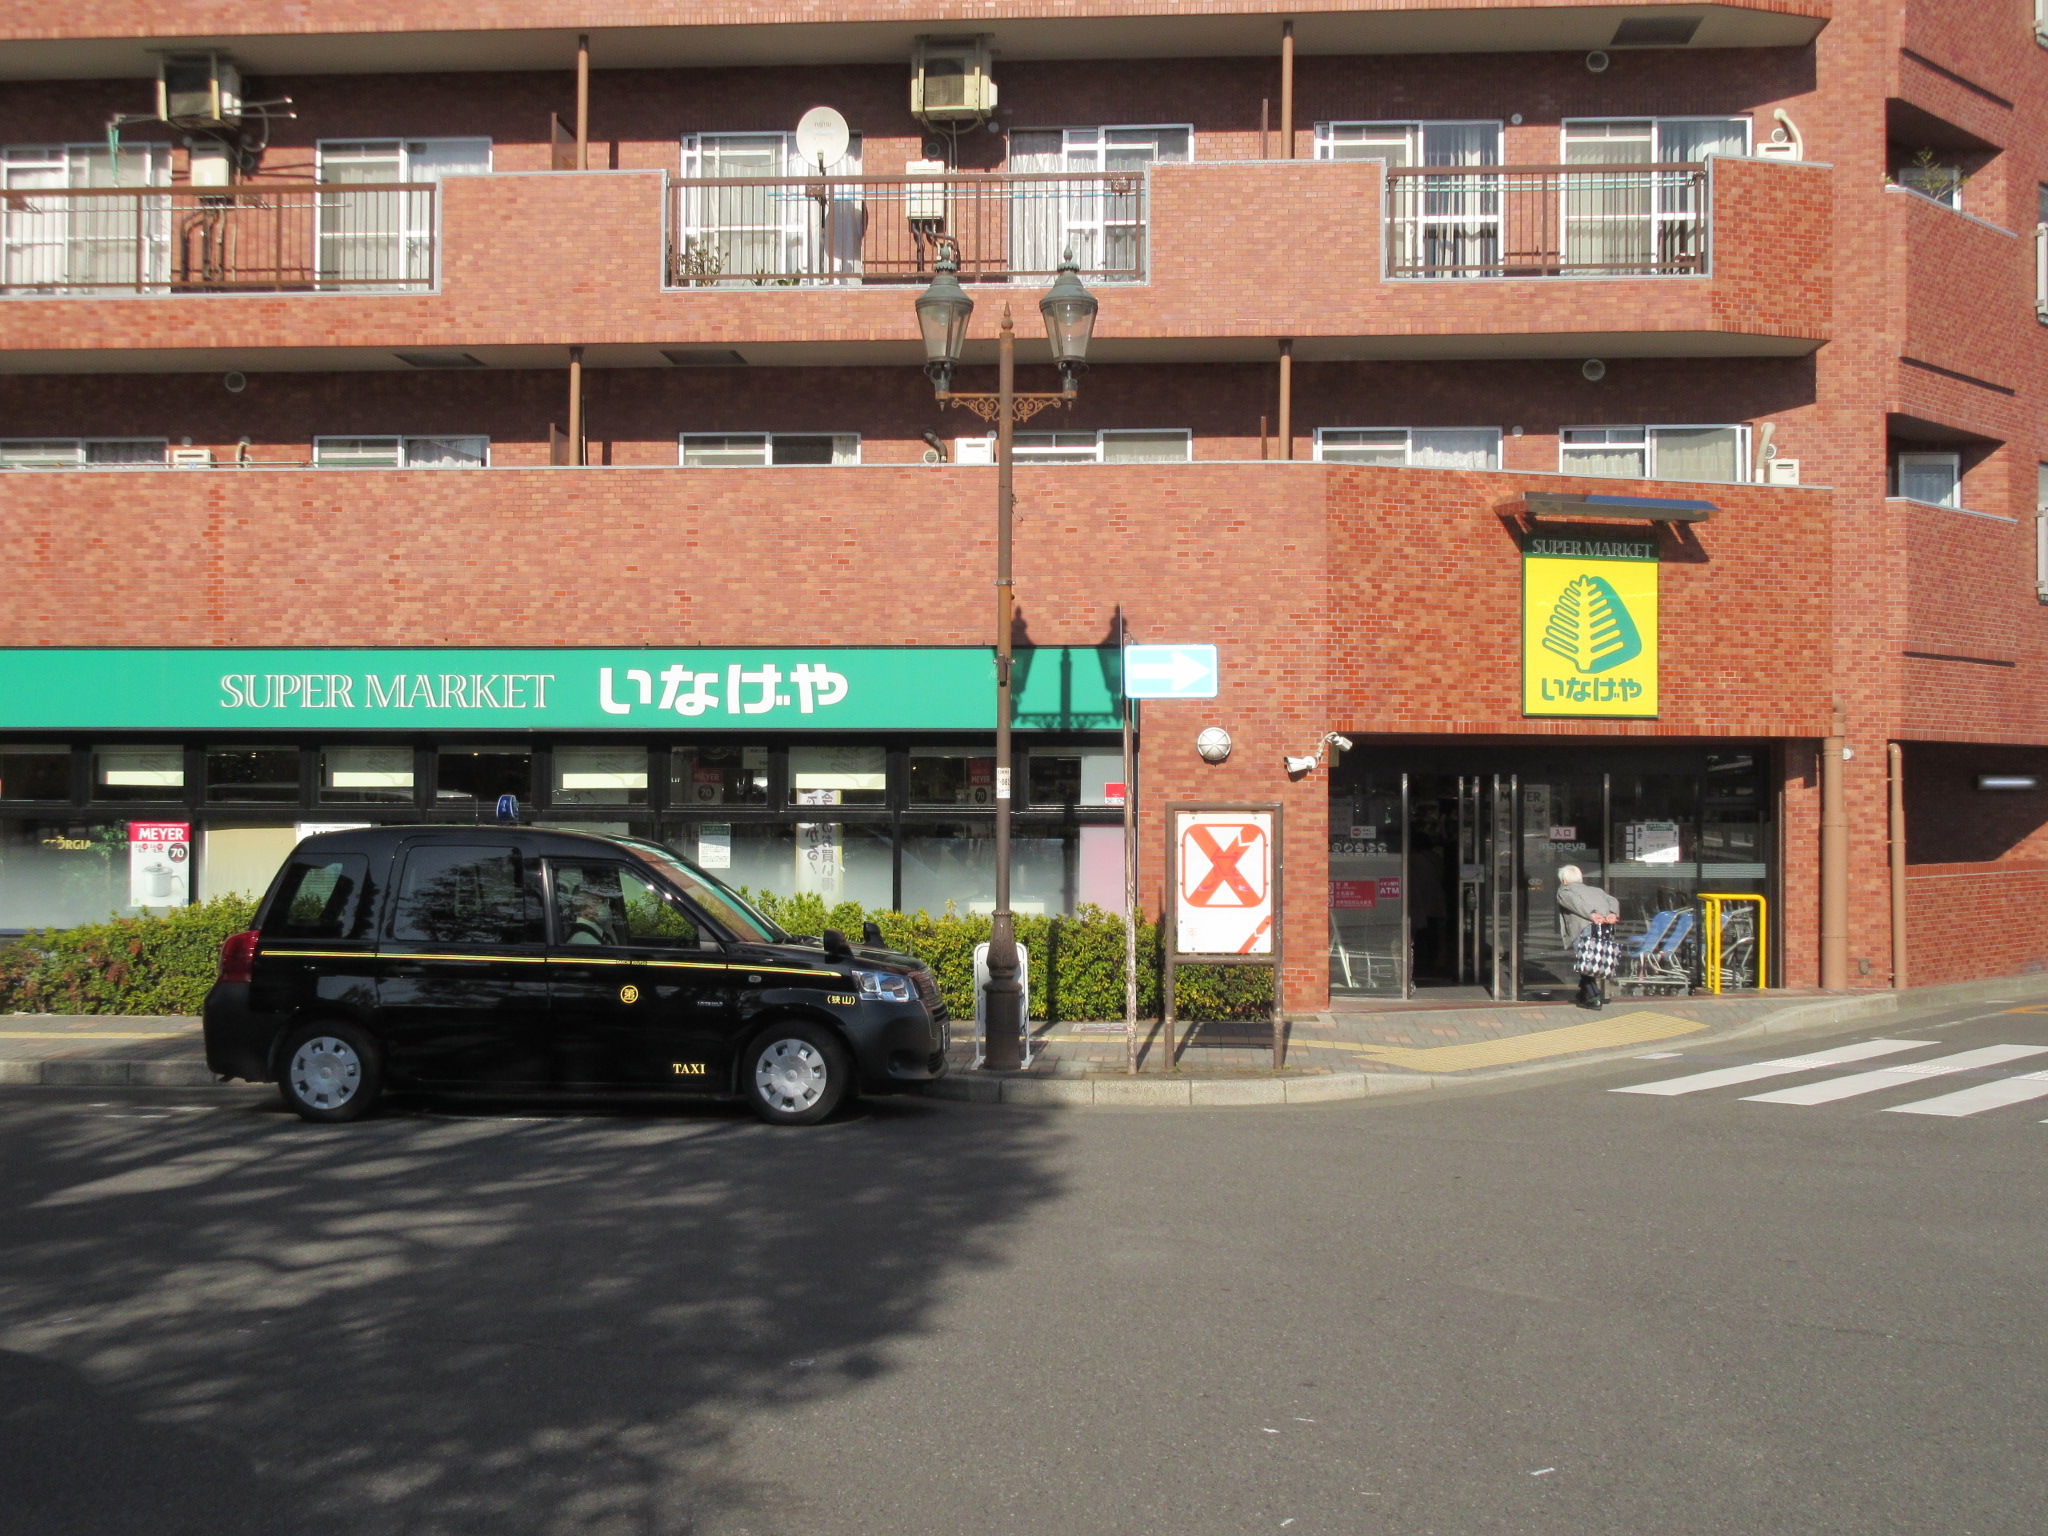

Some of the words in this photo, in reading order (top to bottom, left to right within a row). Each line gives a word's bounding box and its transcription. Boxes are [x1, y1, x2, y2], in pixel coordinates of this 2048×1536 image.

[1532, 539, 1583, 556] SUPER
[1585, 541, 1653, 558] MARKET
[220, 673, 355, 709] SUPER
[364, 673, 556, 709] MARKET
[599, 663, 849, 716] いなげや
[1541, 677, 1643, 702] いなげや
[1501, 791, 1541, 802] MER
[138, 827, 184, 841] MEYER
[1555, 829, 1572, 838] 入口
[170, 848, 184, 858] 70
[672, 1063, 706, 1074] TAXI
